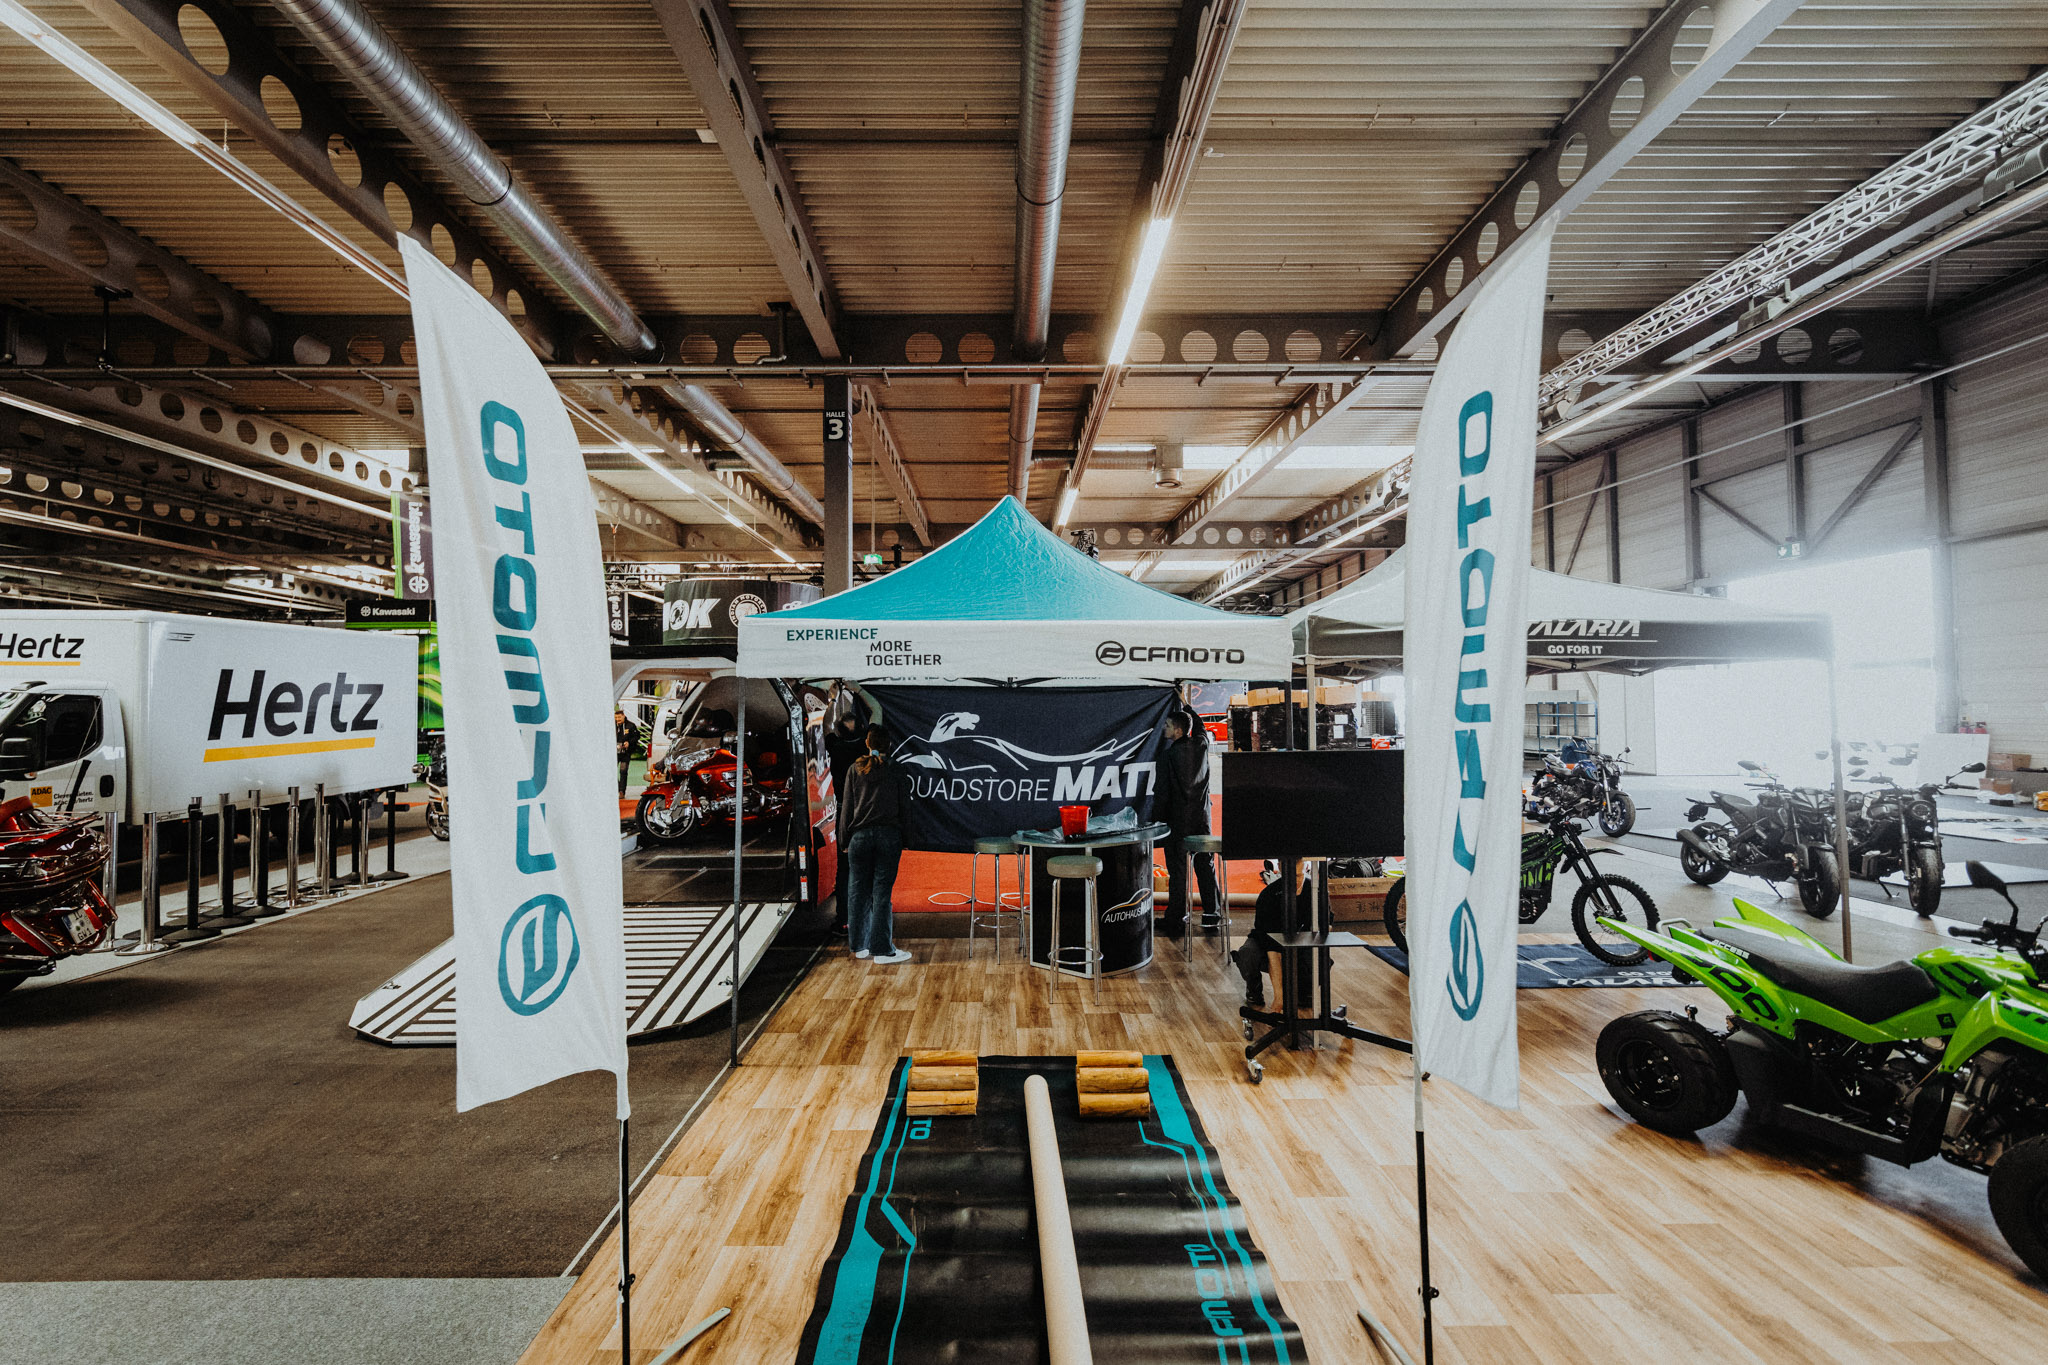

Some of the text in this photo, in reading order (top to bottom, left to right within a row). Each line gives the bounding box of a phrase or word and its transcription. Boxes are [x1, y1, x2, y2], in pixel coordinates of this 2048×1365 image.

[828, 418, 844, 440] 3
[404, 501, 425, 574] Kawasaki
[372, 607, 416, 616] Kawasaki
[786, 628, 879, 641] EXPERIENCE
[0, 632, 85, 659] Hertz
[870, 640, 913, 652] MORE
[1547, 645, 1603, 655] GO FOR IT
[865, 654, 942, 667] TOGETHER
[1129, 646, 1245, 664] CFMOTO
[207, 669, 384, 741] Hertz
[31, 787, 52, 796] ADAC
[1104, 906, 1141, 923] AUTOHAUS
[1711, 939, 1750, 960] ACCESS
[1550, 977, 1706, 986] TALAR
